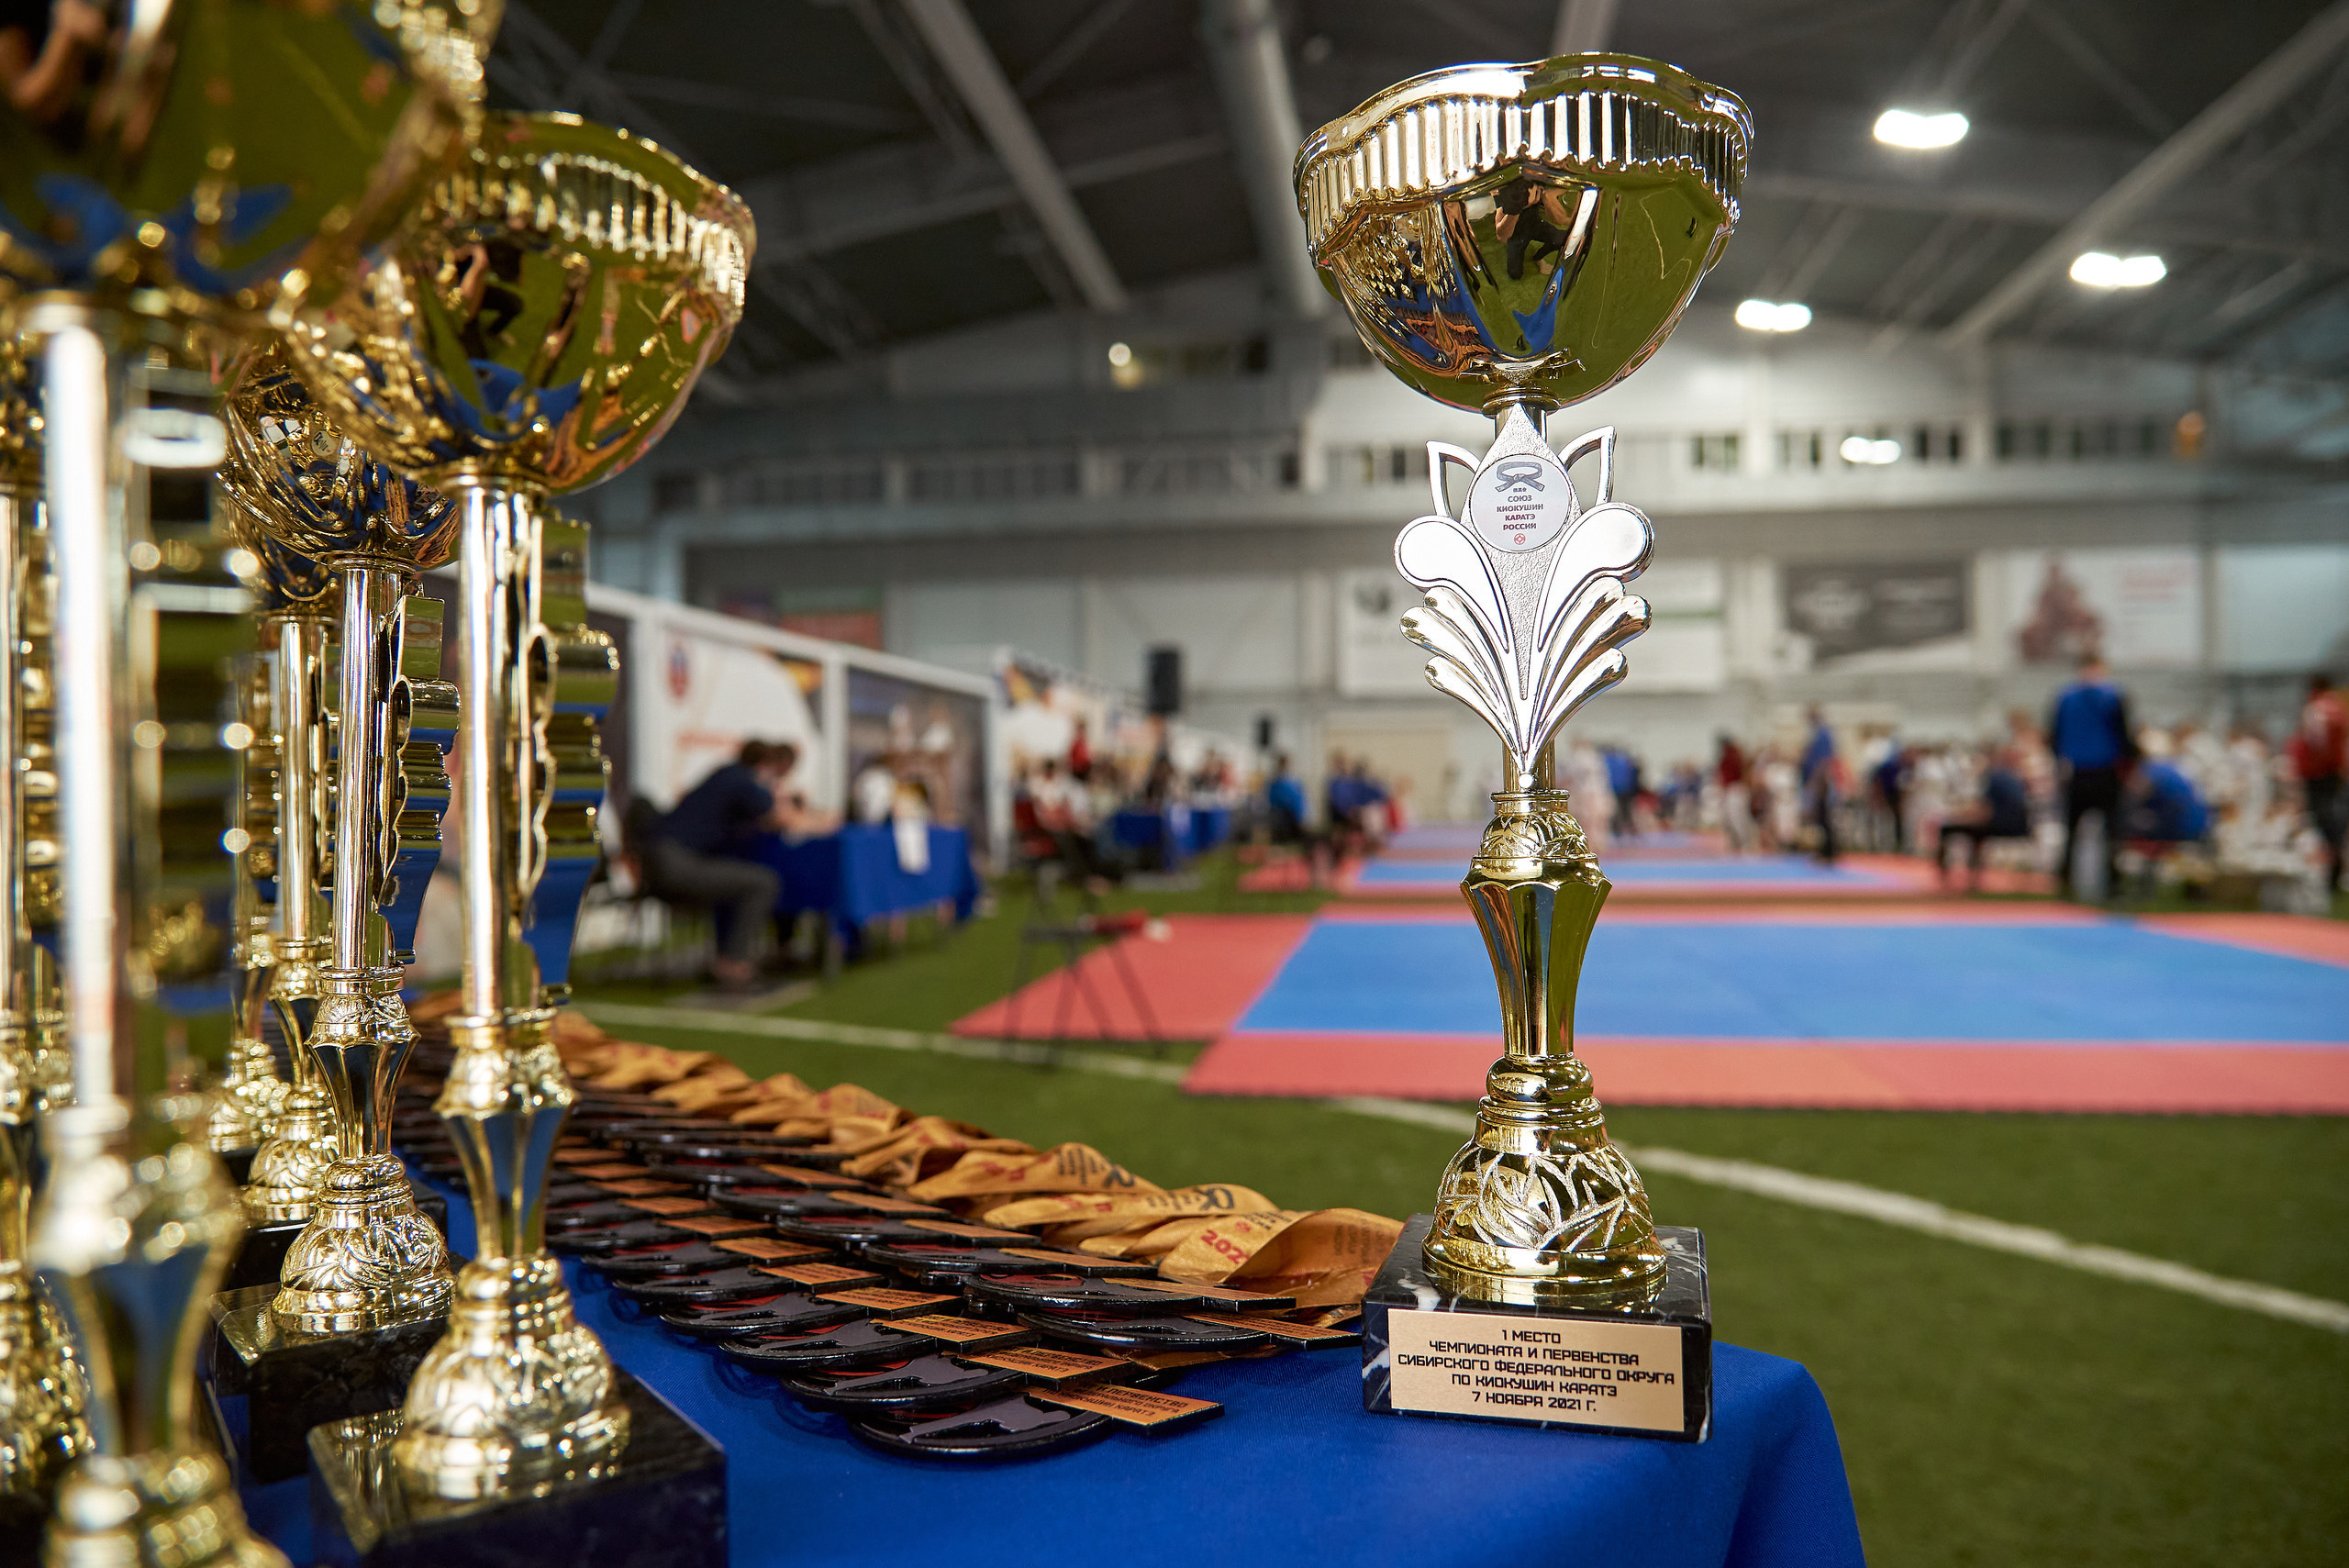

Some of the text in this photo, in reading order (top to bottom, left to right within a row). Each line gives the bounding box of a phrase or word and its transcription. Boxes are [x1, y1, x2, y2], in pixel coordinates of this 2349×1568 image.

[1497, 504, 1544, 513] КИОКУШИН
[1508, 495, 1532, 503] СОЮЗ
[1505, 513, 1536, 521] КАРАТЭ
[1200, 1229, 1250, 1264] 202
[1502, 1329, 1561, 1344] 1 МЕСТО
[1429, 1340, 1639, 1366] ЧЕМПИОНАТА И ПЕРВЕНСТВА
[1397, 1353, 1675, 1385] СИБИРСКОГО ФЕДЕРАЛЬНОГО ОКРУГА
[1452, 1373, 1618, 1397] ПО КИОКУШИН КАРАТЭ
[1108, 1387, 1188, 1408] ПЕРВЕНСТВО
[1472, 1391, 1597, 1412] 7 НОЯБРЯ 2021 Г.
